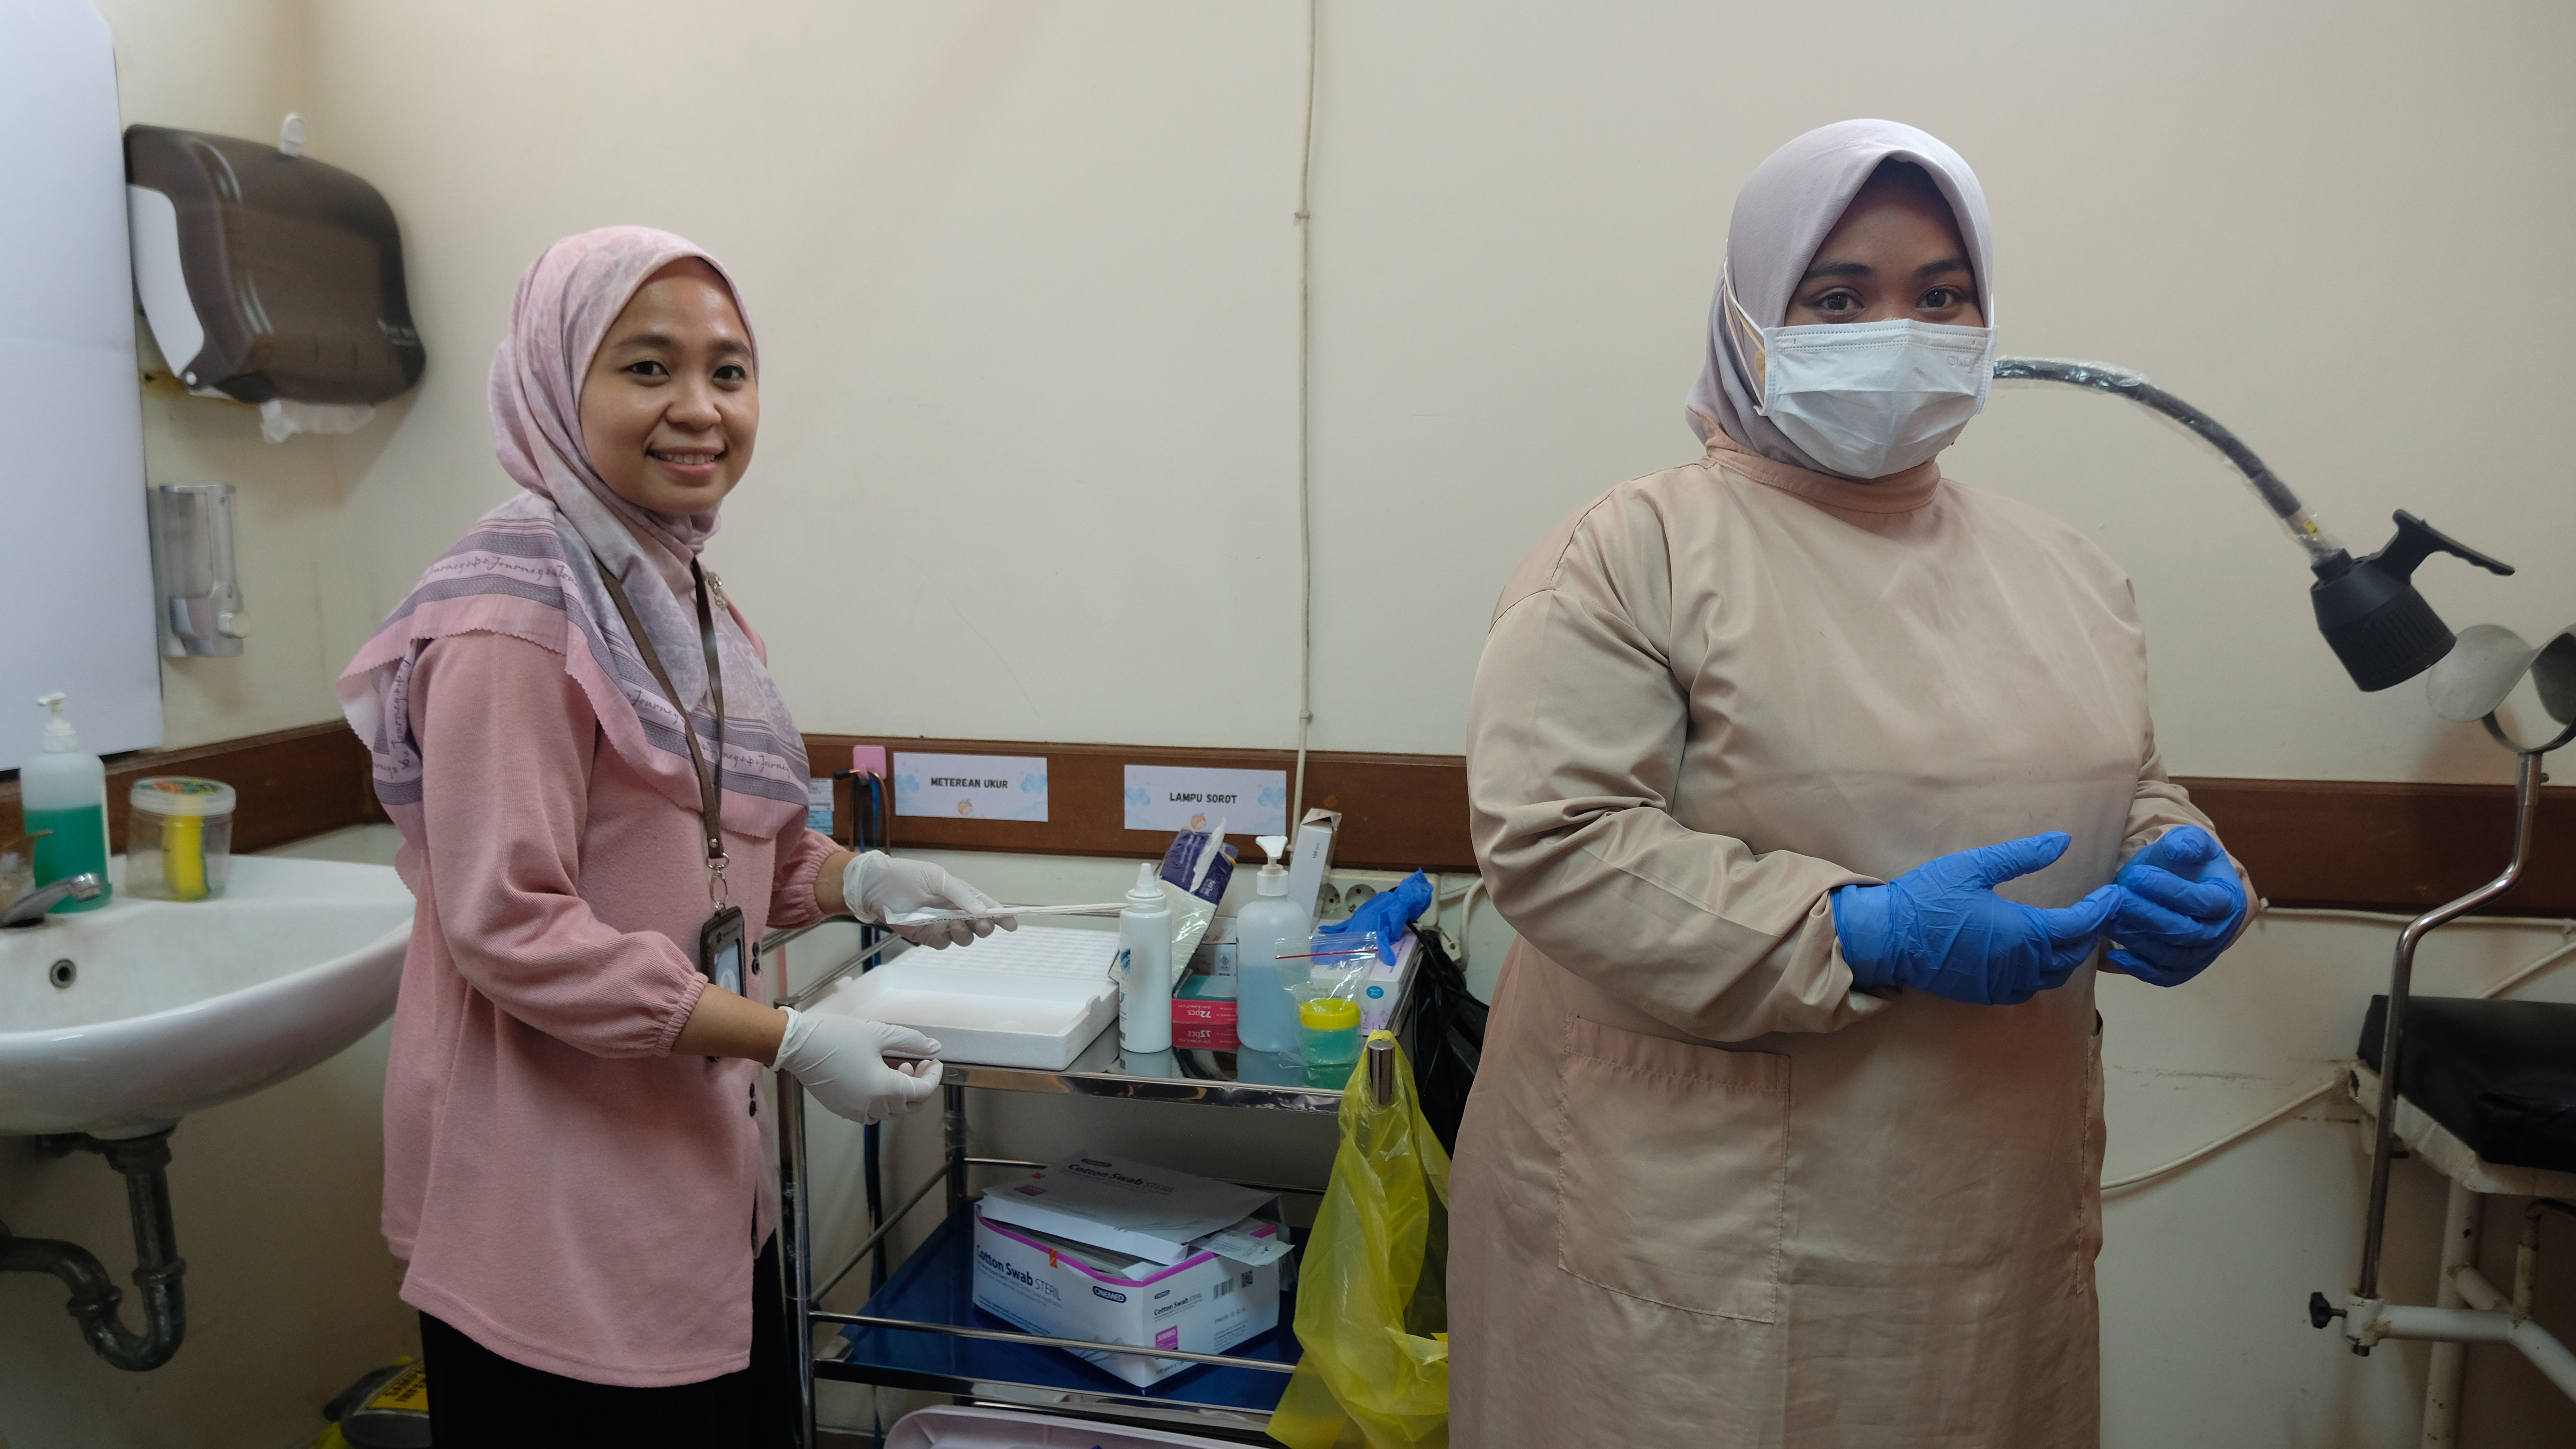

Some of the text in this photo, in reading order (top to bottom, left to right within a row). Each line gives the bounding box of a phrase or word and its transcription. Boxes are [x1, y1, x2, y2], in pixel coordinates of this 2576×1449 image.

[931, 778, 1008, 788] METEREAN UKUR
[1170, 792, 1237, 804] LAMPU SOROT
[1188, 1009, 1212, 1018] 72pcs
[1069, 1164, 1109, 1178] Cotton
[1109, 1173, 1143, 1185] Swab
[1005, 1263, 1033, 1286] Swab
[1035, 1278, 1061, 1301] STERIL
[1094, 1287, 1125, 1302] ONEMED
[1154, 1305, 1173, 1316] Cotton
[1173, 1298, 1189, 1308] Swab
